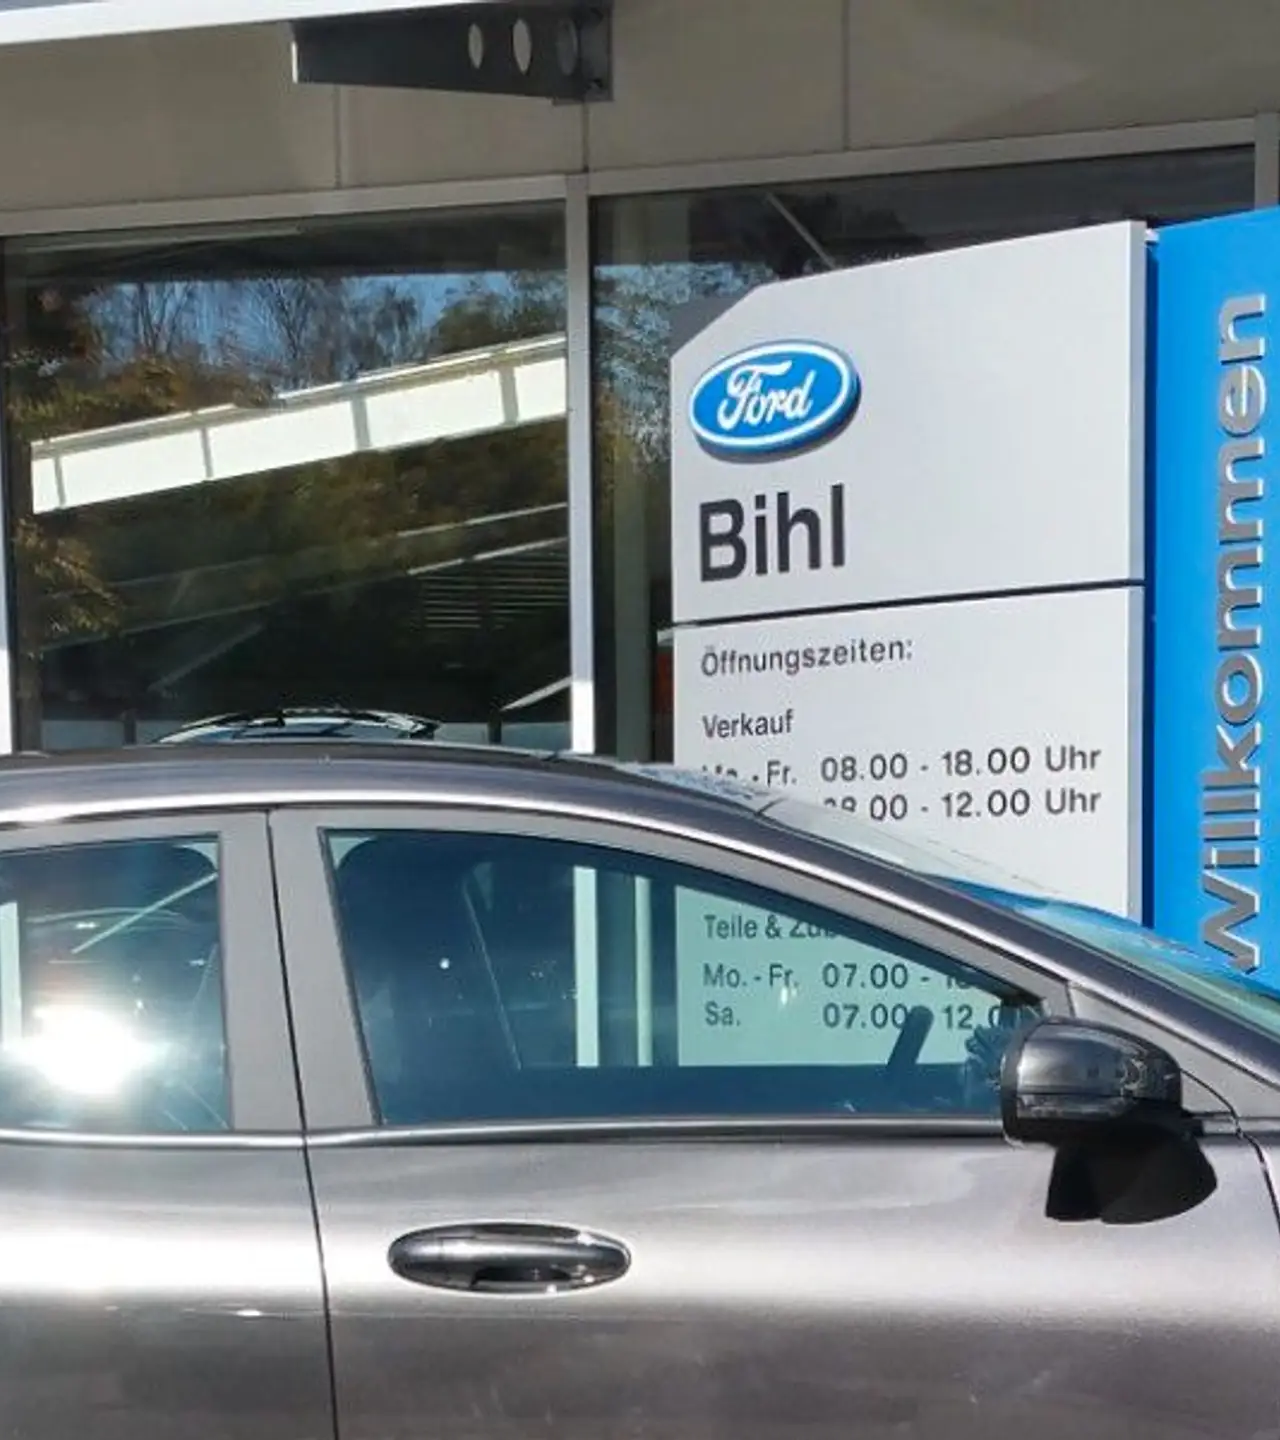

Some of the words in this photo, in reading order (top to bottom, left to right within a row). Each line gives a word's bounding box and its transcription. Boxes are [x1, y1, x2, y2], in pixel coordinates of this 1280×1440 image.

[717, 360, 814, 430] Ford
[699, 484, 846, 582] Bihl
[1201, 294, 1266, 973] Willkommen
[701, 637, 913, 678] Öffnungszeiten:
[702, 709, 793, 740] Verkauf
[767, 759, 798, 787] Fr.
[821, 753, 908, 782] 08.00
[941, 746, 1030, 776] 18.00
[1045, 744, 1102, 772] Uhr
[941, 787, 1030, 817] 12.00
[1045, 787, 1102, 815] Uhr
[704, 915, 757, 938] Teile
[765, 914, 781, 939] &
[704, 963, 746, 988] Mo.
[769, 964, 799, 988] Fr.
[823, 962, 909, 989] 07.00
[704, 1002, 741, 1027] Sa.
